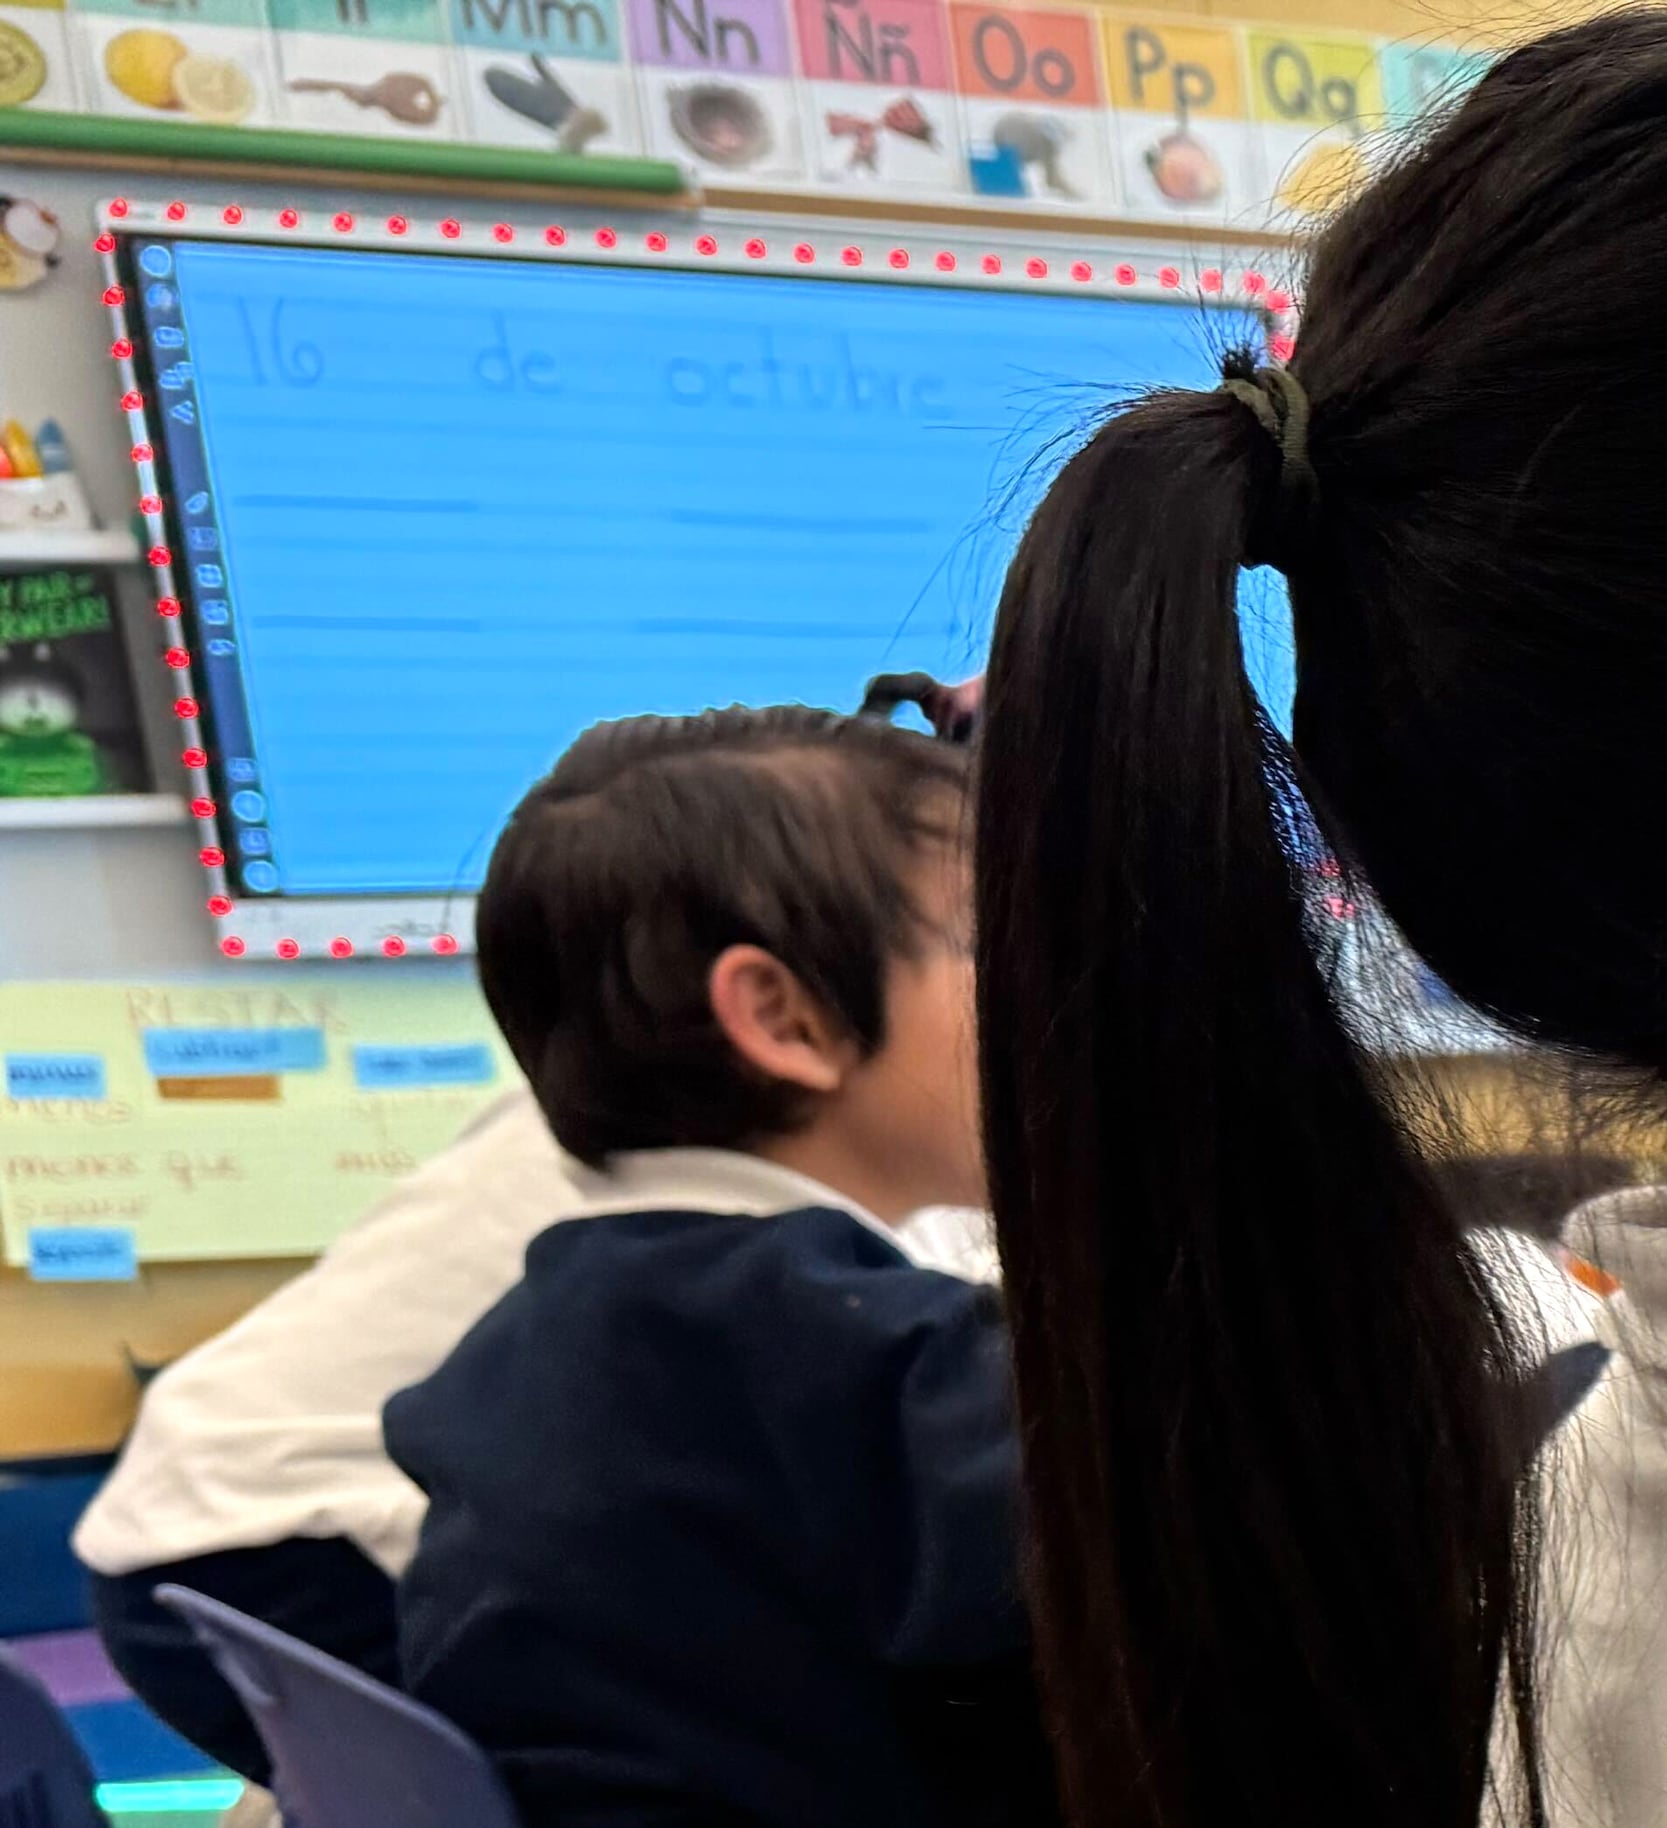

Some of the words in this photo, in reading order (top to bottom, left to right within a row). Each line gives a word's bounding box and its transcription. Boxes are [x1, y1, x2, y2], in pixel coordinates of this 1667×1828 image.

[656, 0, 760, 63] Nn
[973, 15, 1075, 95] Oo
[1125, 26, 1214, 129] Pp
[1262, 45, 1363, 138] Qq
[234, 295, 325, 388] 16
[472, 312, 562, 394] de
